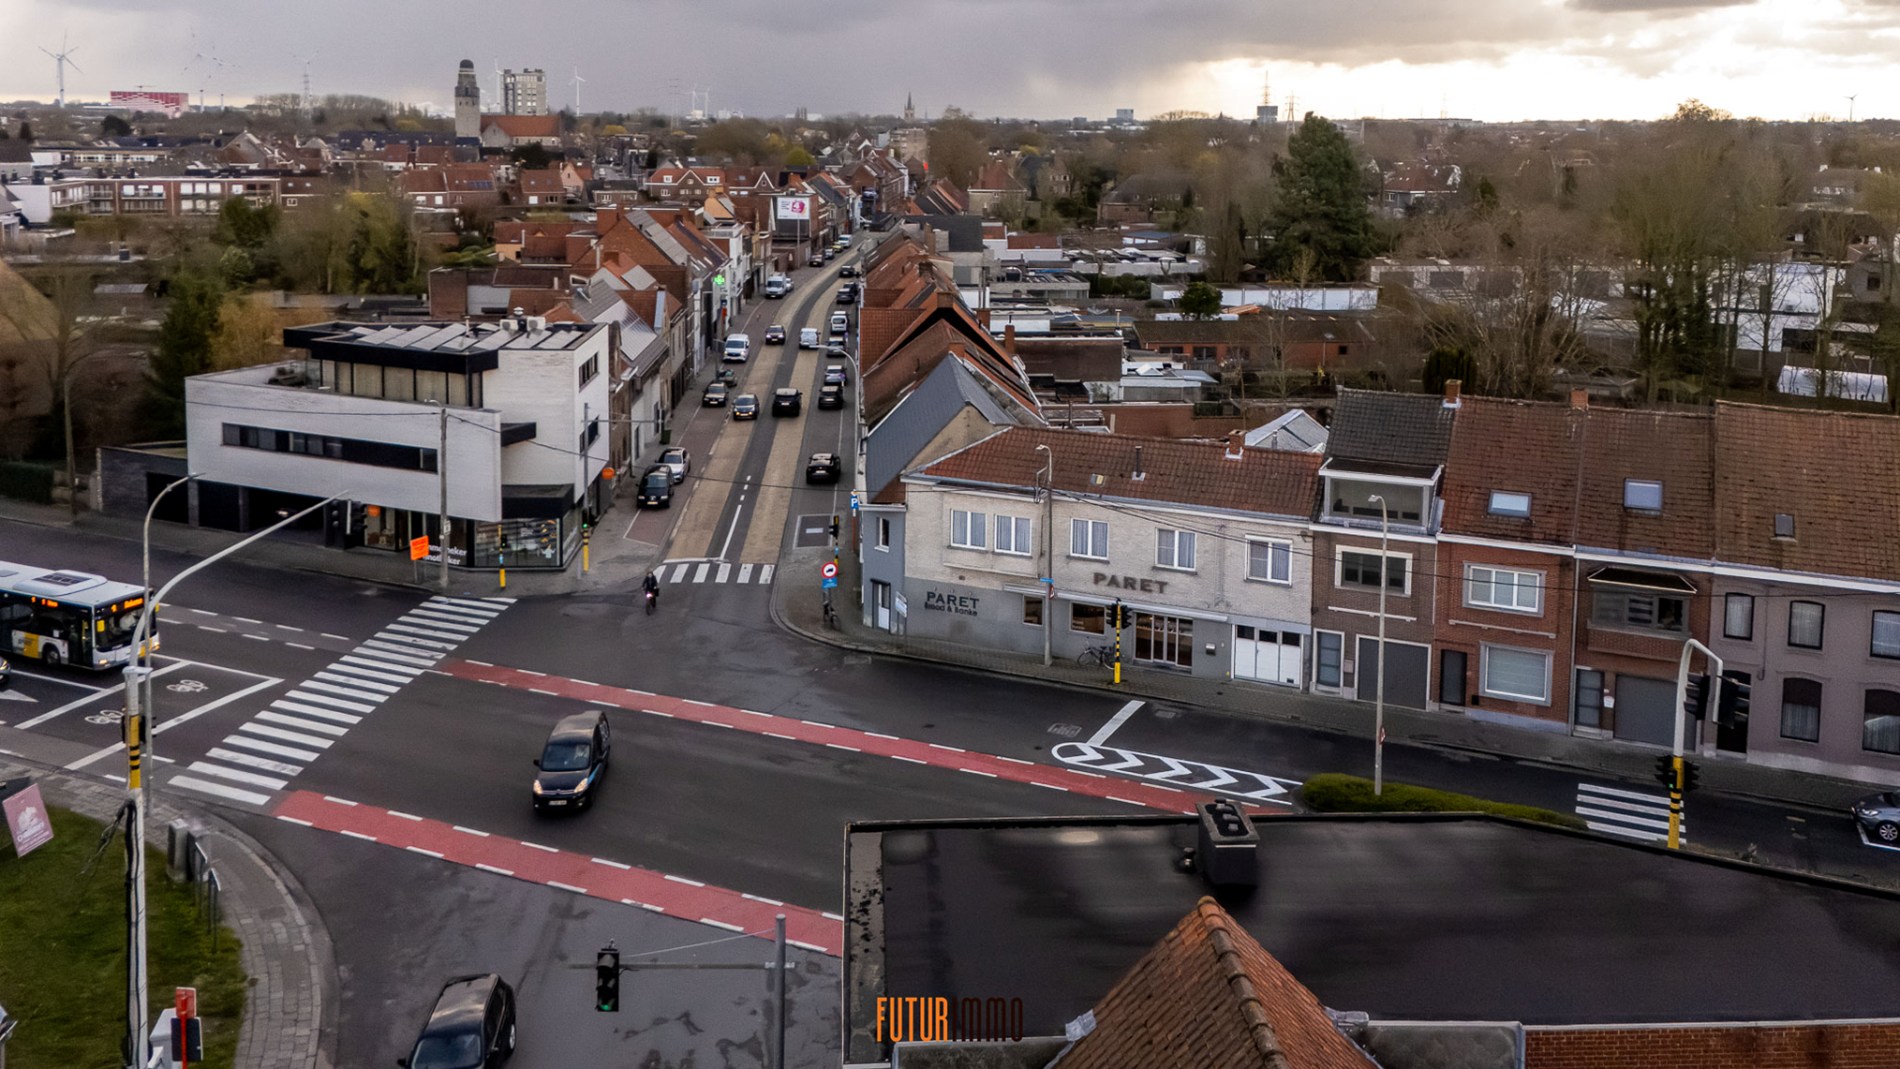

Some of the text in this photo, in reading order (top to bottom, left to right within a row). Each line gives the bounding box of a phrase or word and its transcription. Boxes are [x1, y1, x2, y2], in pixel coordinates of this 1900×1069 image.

[851, 498, 858, 507] P
[1093, 572, 1168, 594] PARET
[926, 591, 980, 609] PARET
